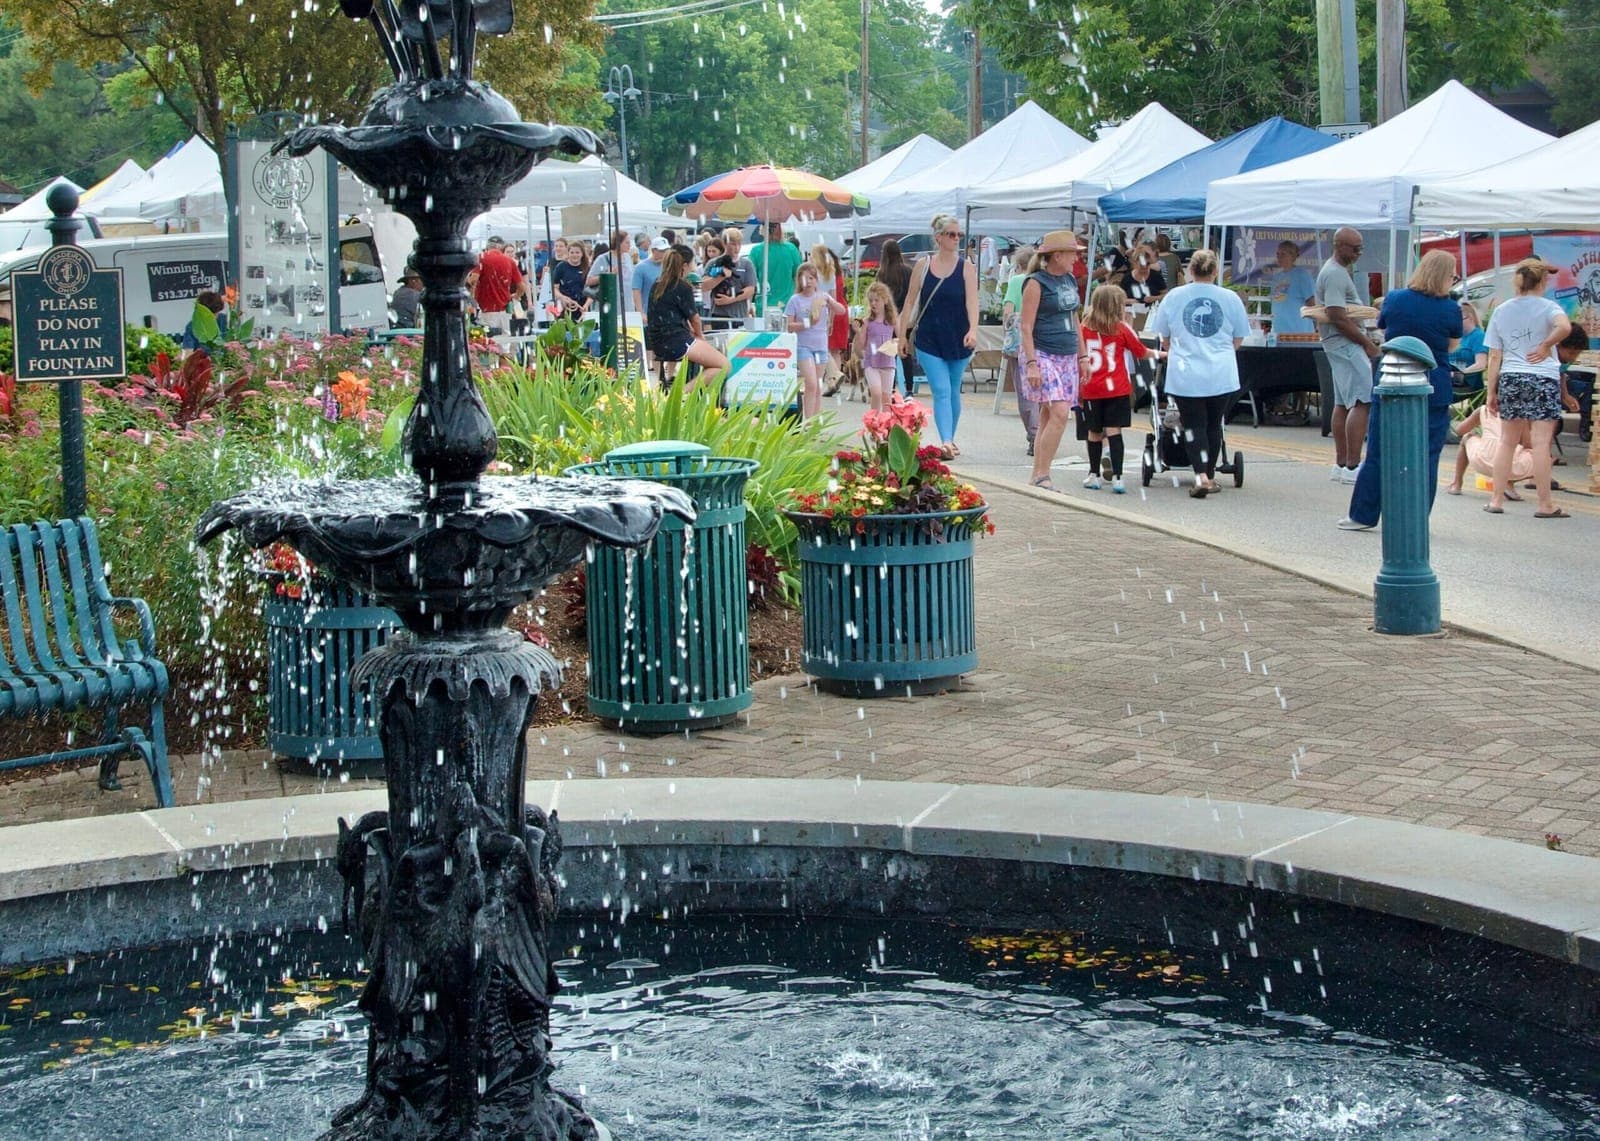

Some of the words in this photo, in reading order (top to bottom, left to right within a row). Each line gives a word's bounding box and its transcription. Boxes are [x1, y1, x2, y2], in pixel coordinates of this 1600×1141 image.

[150, 263, 199, 275] Winning
[190, 270, 217, 286] Edge
[40, 297, 98, 312] PLEASE
[37, 318, 63, 331] DO
[67, 317, 102, 331] NOT
[40, 337, 80, 351] PLAY
[84, 336, 102, 349] IN
[1086, 338, 1117, 373] 51
[29, 356, 114, 371] FOUNTAIN
